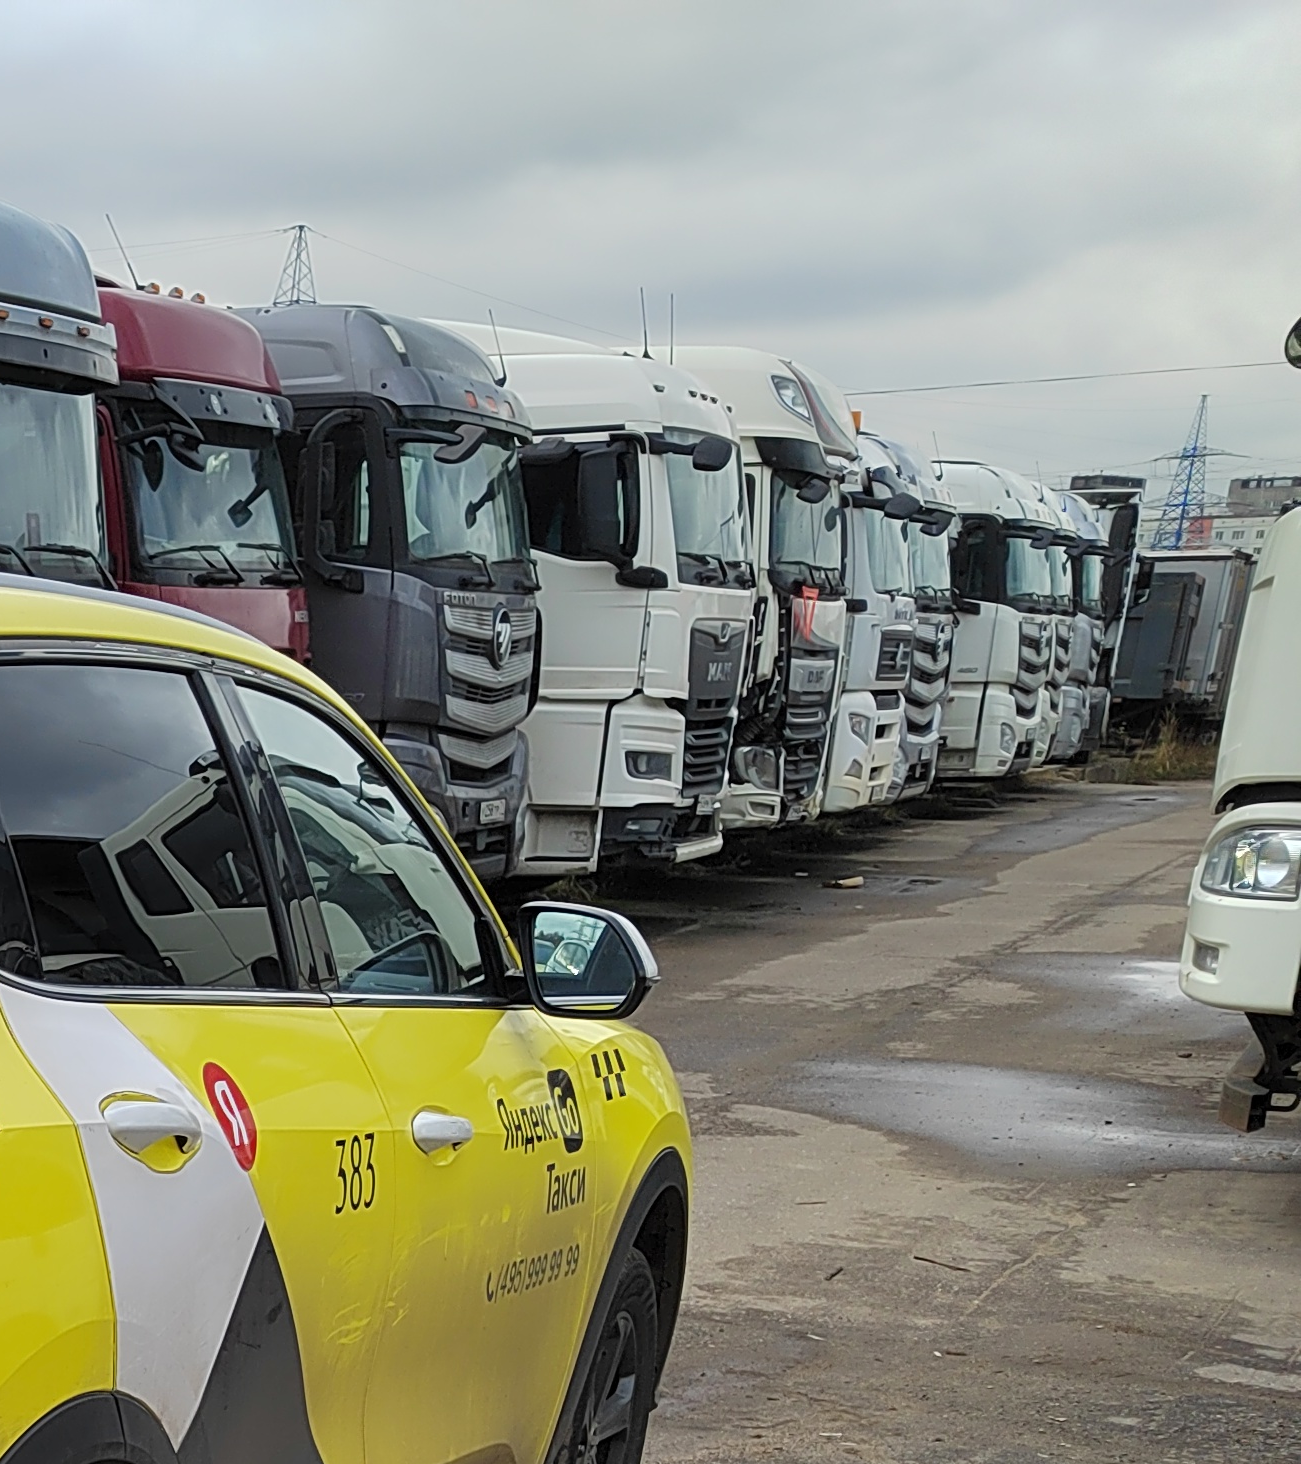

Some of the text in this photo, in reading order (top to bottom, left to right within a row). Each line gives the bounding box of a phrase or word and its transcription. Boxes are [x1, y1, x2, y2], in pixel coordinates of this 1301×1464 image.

[497, 1086, 580, 1154] Яндекс Go
[335, 1132, 376, 1215] 383
[546, 1162, 586, 1215] Такси
[548, 1248, 563, 1282] 99
[564, 1243, 580, 1278] 99
